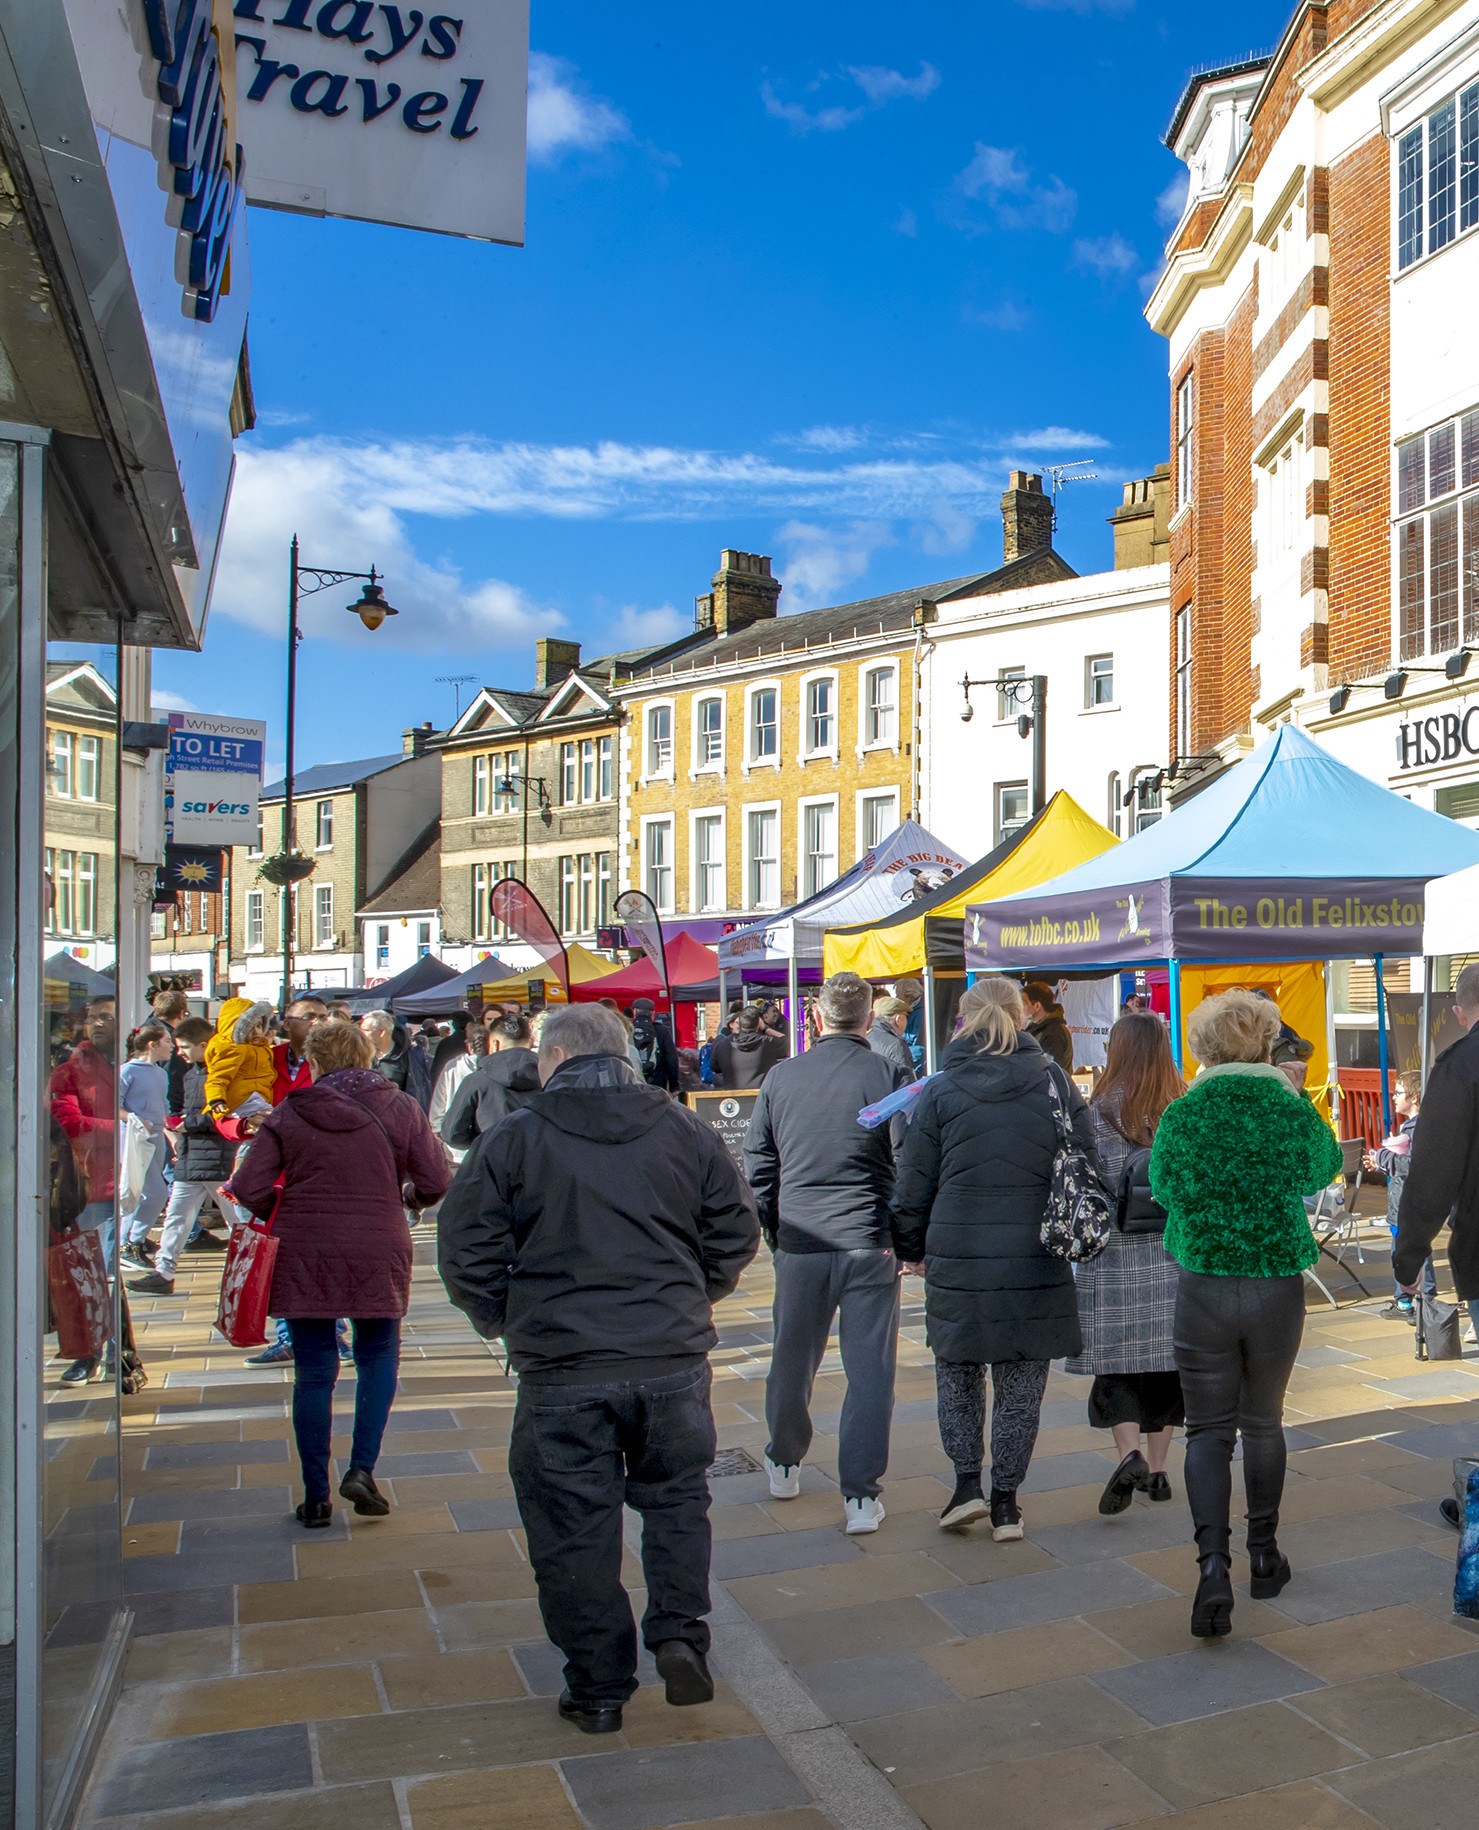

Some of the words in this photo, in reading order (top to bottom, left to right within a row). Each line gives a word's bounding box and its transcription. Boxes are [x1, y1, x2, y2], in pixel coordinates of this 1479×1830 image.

[186, 719, 258, 736] Whybrow
[172, 737, 203, 754] TO
[209, 740, 245, 758] LET
[177, 754, 200, 763] Street
[202, 757, 225, 765] Retail
[226, 759, 259, 769] Premises
[181, 799, 251, 815] savers
[882, 858, 908, 875] THE
[906, 852, 931, 863] BIG
[935, 854, 965, 871] BEA
[1195, 899, 1248, 929] The
[1256, 897, 1303, 928] Old
[1000, 911, 1100, 948] www.tofbc.co.uk
